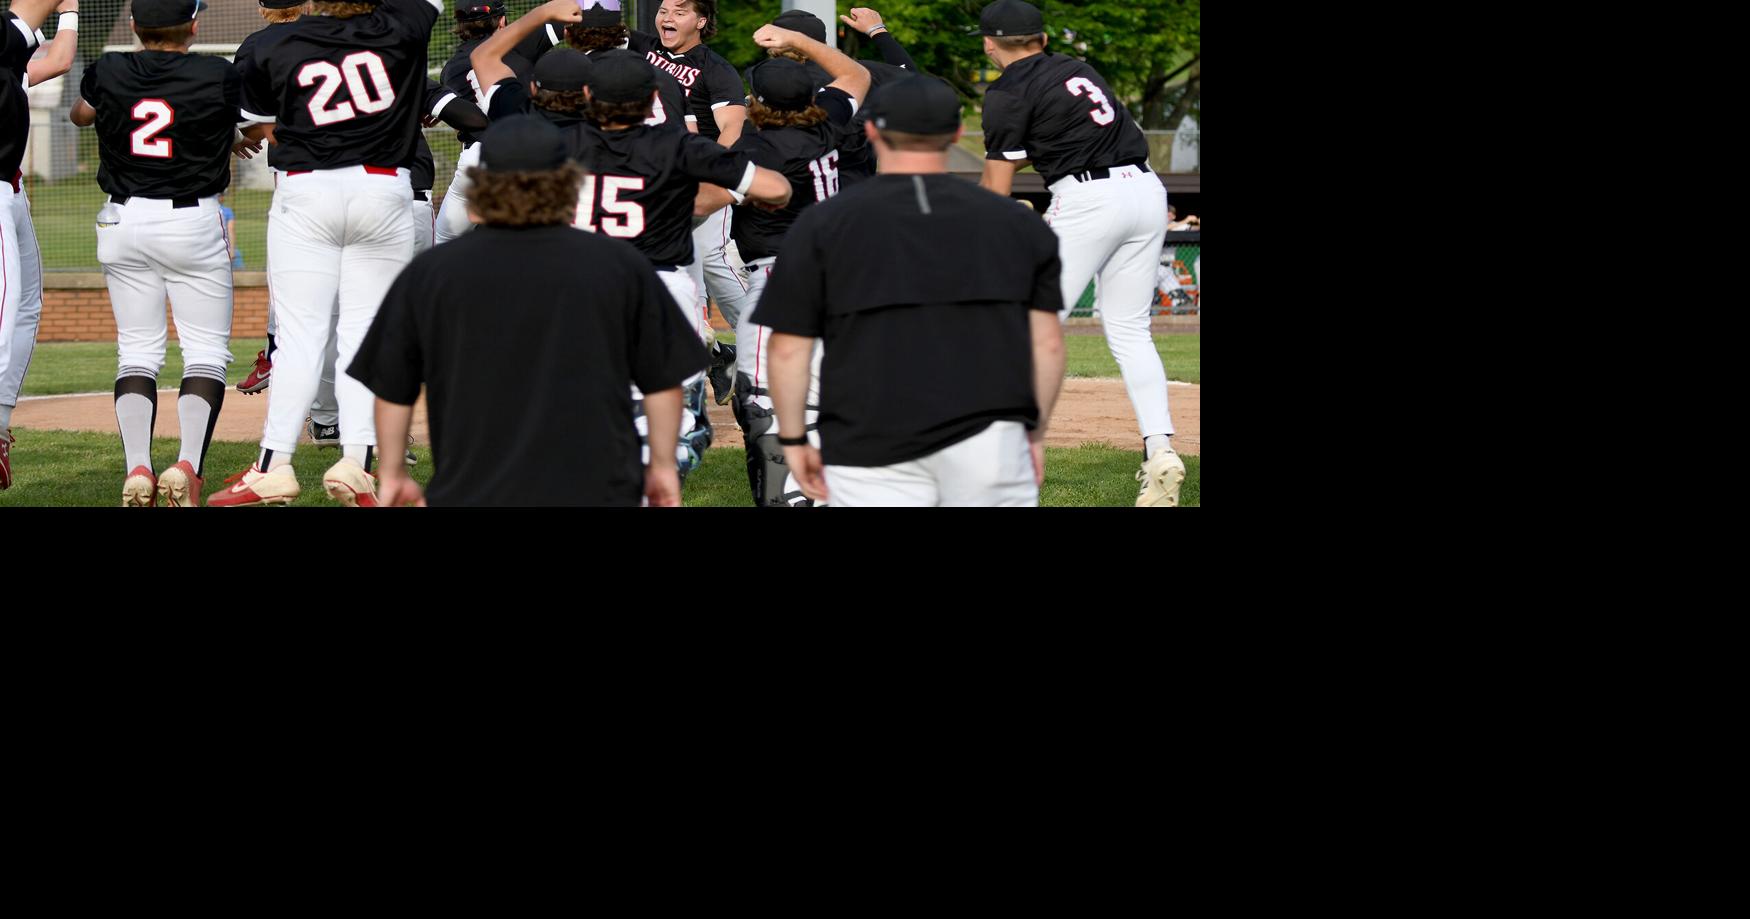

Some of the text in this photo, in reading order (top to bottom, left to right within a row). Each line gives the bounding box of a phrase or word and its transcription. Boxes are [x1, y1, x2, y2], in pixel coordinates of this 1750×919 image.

[297, 50, 396, 127] 20
[1064, 75, 1116, 126] 3
[130, 98, 174, 158] 2
[808, 148, 839, 202] 16
[569, 173, 645, 238] 15
